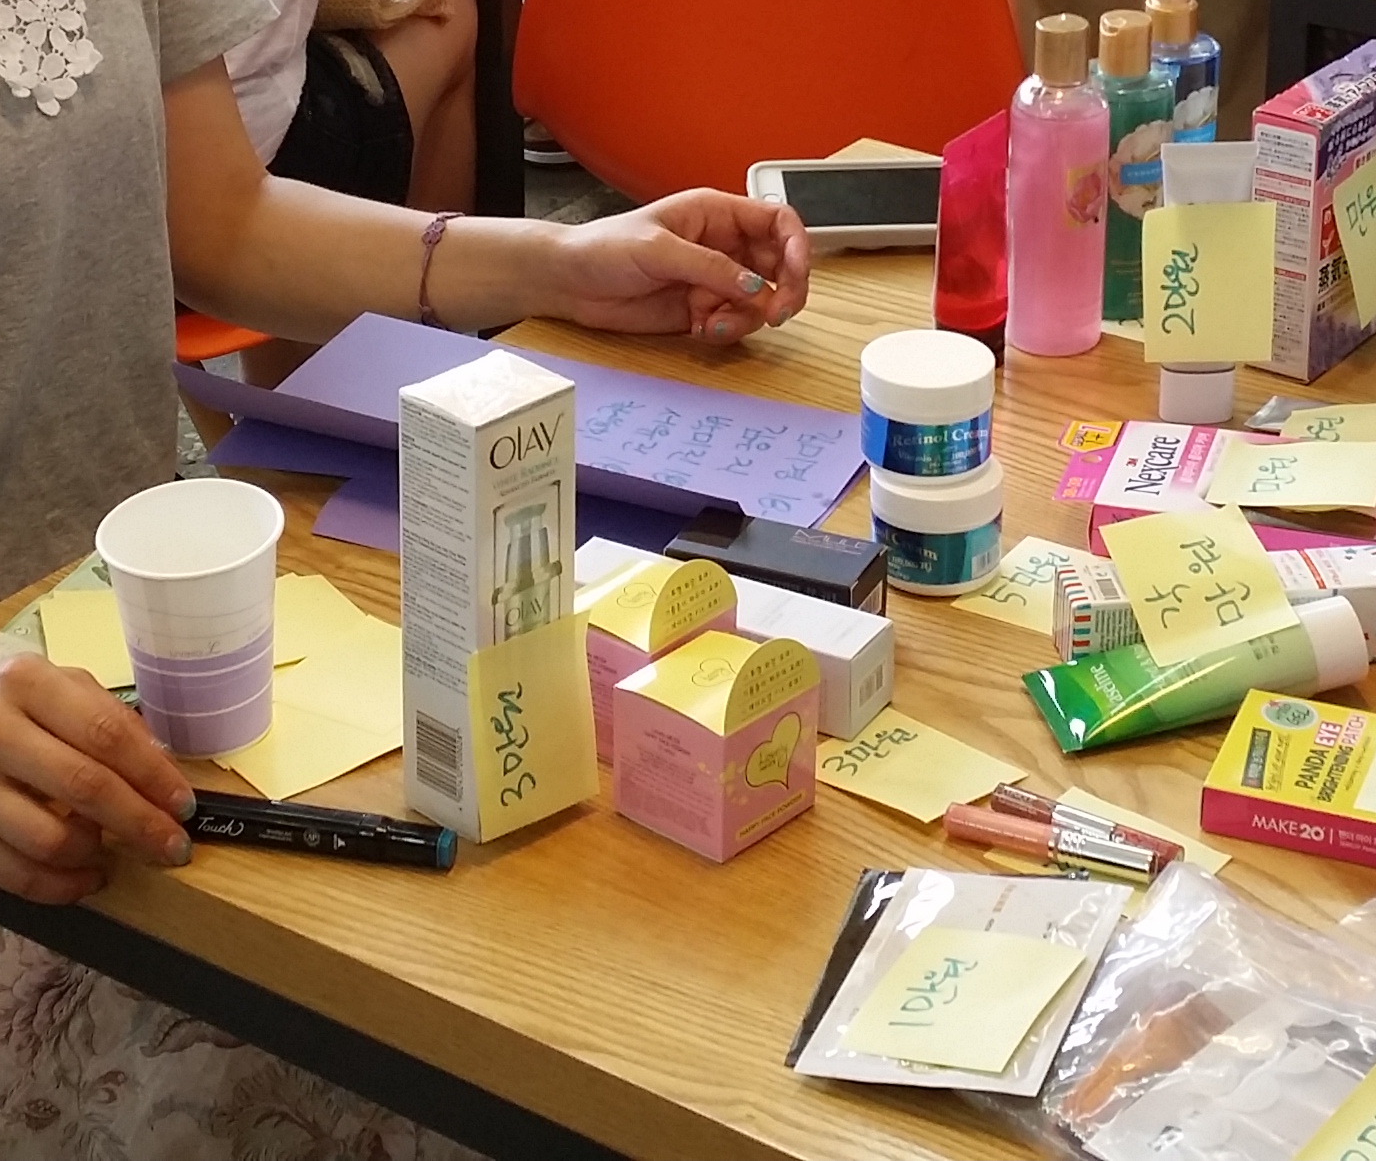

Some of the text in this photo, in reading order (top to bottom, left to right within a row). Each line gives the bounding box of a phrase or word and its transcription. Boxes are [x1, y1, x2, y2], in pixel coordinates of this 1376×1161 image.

[1161, 241, 1198, 335] 2만원
[1124, 435, 1181, 495] Nexcare
[1247, 455, 1298, 495] 만원
[983, 552, 1070, 607] 5만원
[491, 681, 536, 808] 3만원
[821, 726, 919, 777] 3만원
[1295, 722, 1341, 790] PANDA EYE
[1342, 715, 1366, 746] PATCH
[197, 816, 244, 836] Touch
[1252, 814, 1298, 837] MAKE
[888, 956, 979, 1027] 1만원
